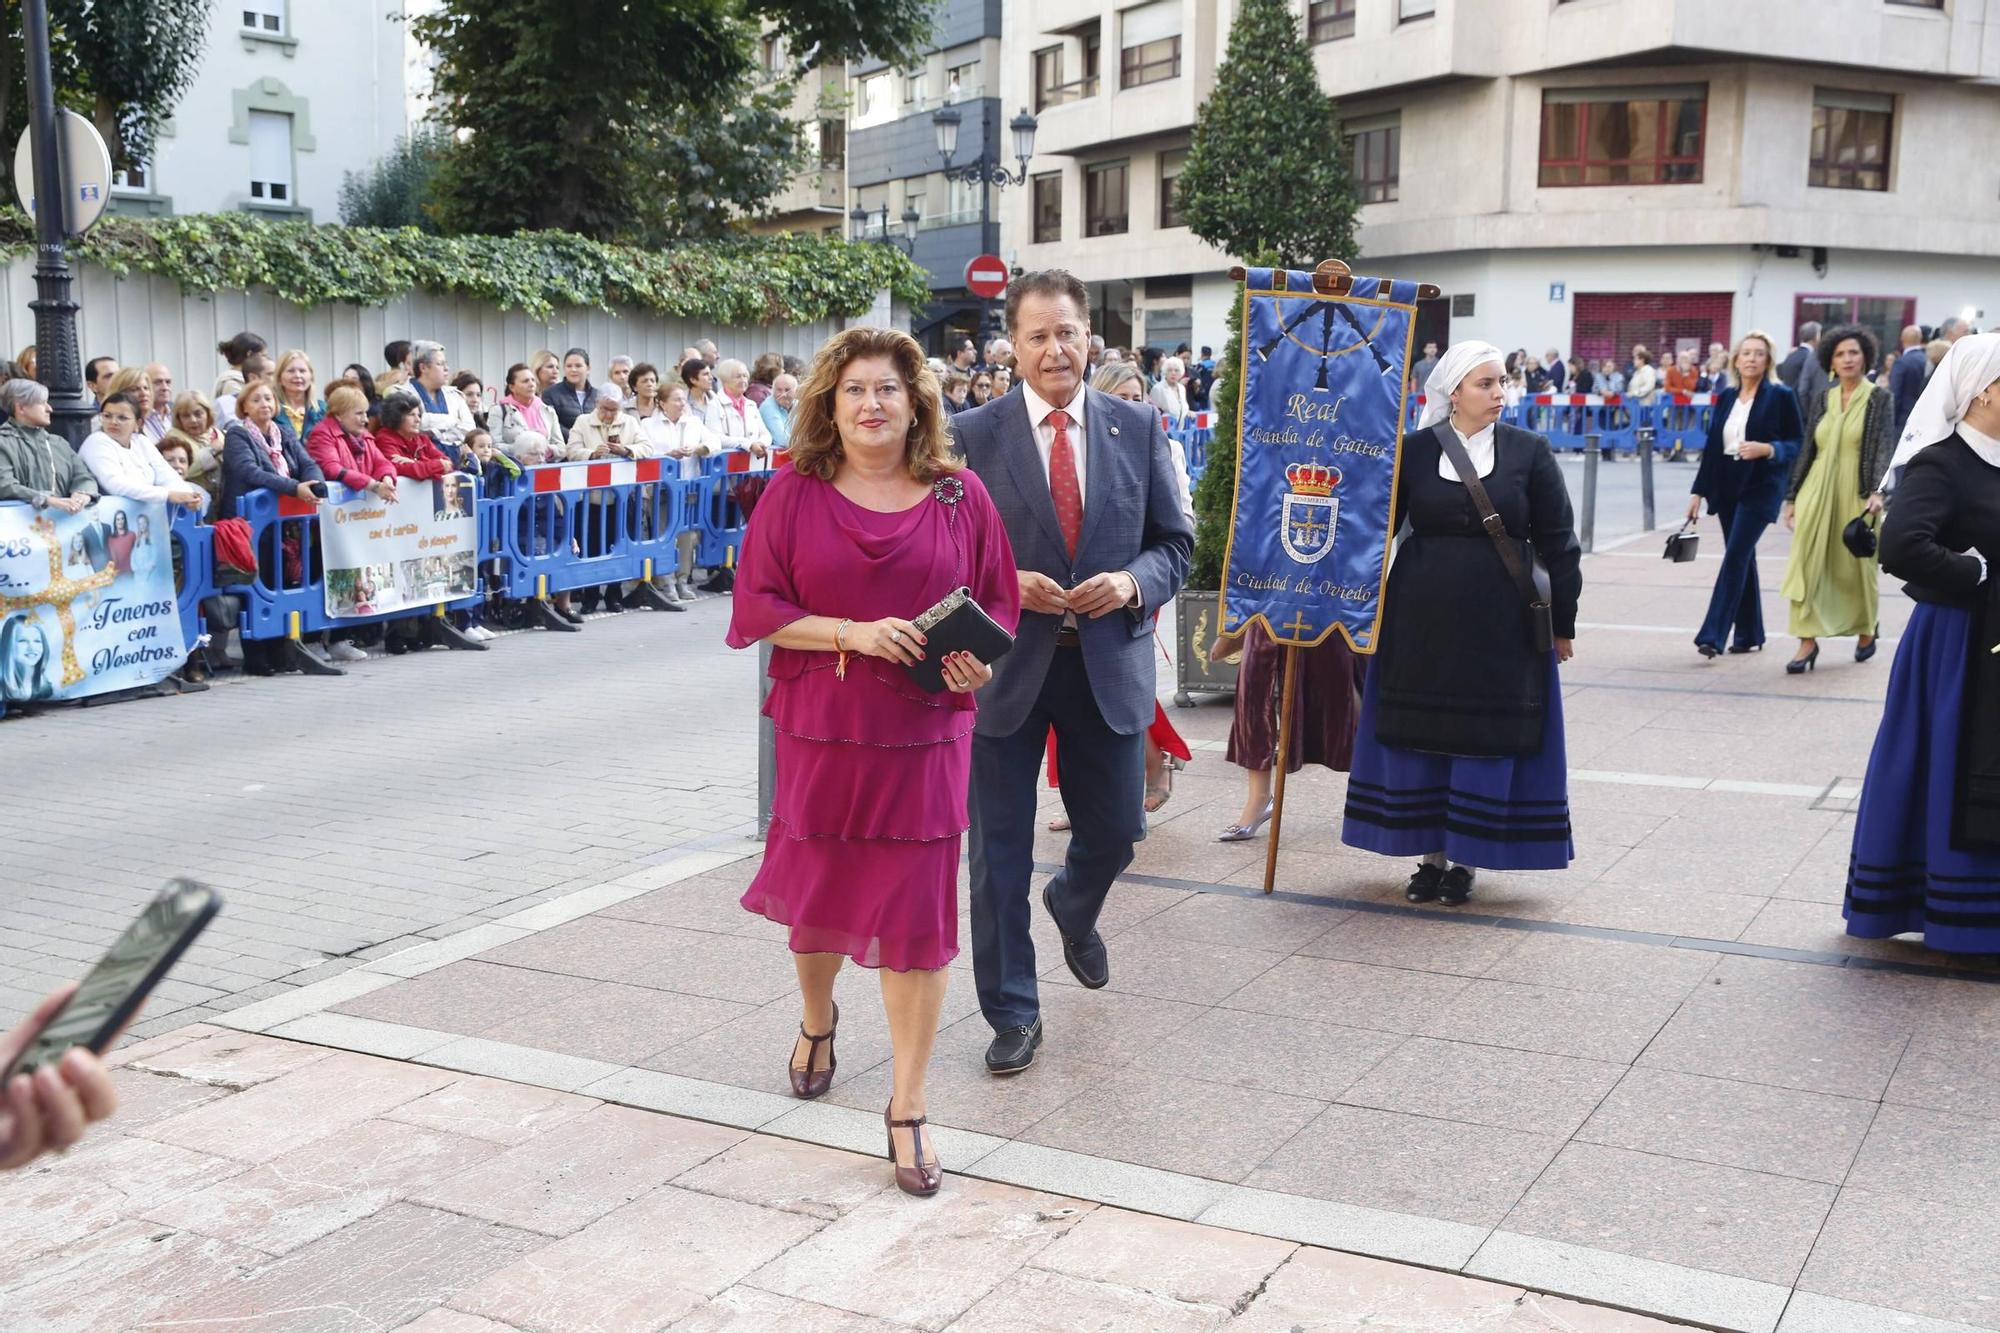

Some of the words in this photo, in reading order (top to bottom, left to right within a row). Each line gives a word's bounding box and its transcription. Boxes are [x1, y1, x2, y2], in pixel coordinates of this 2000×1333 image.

[1285, 393, 1346, 423] Real
[1251, 425, 1299, 444] Banda
[1306, 428, 1324, 447] de
[1333, 435, 1388, 457] Gaitas
[1237, 572, 1291, 591] Ciudad
[1295, 576, 1312, 594] de
[1319, 580, 1372, 602] Oviedo
[127, 625, 157, 642] con
[92, 644, 178, 676] Nosotros.
